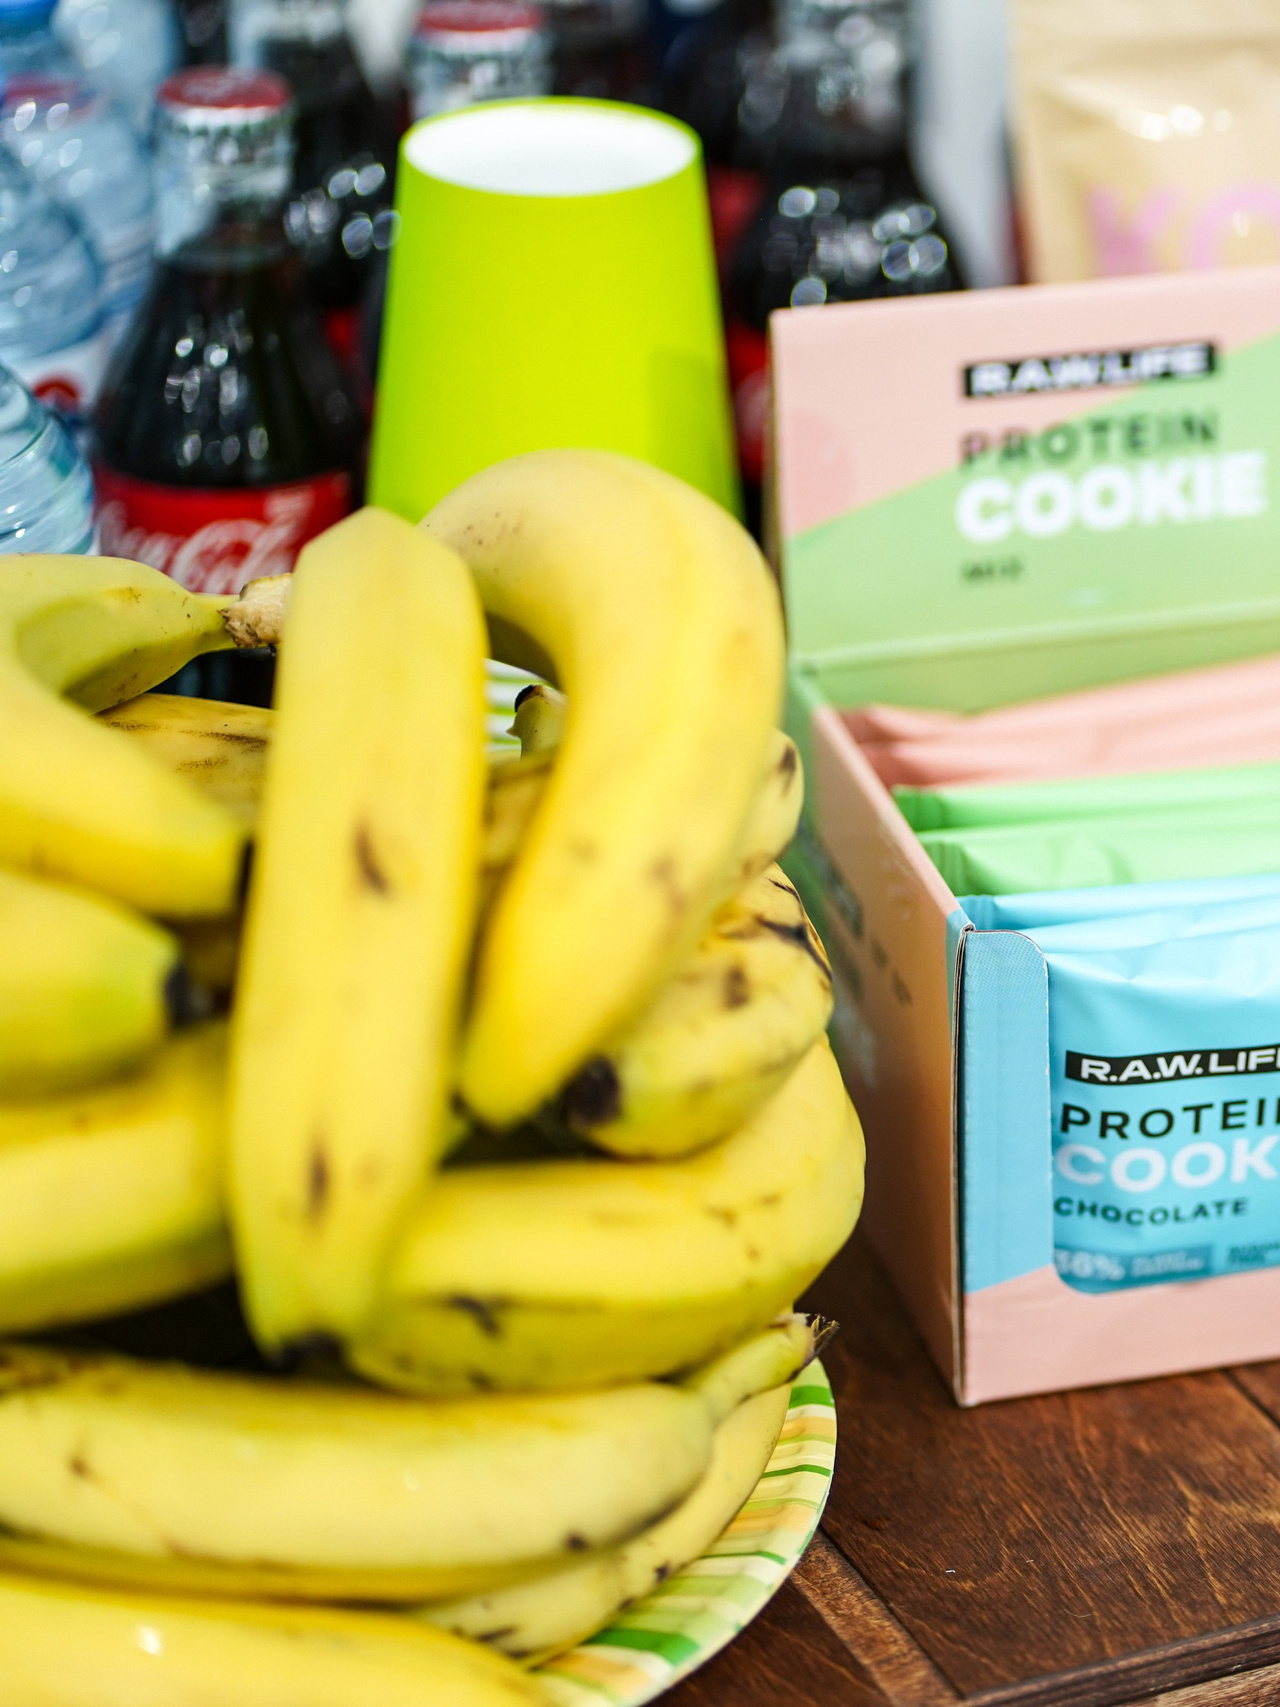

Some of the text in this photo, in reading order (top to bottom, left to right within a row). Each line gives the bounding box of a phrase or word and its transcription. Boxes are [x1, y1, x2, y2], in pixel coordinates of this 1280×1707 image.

[961, 409, 1218, 467] PROTEIN
[956, 450, 1267, 543] COOKIE
[1053, 1196, 1247, 1227] CHOCOLATE
